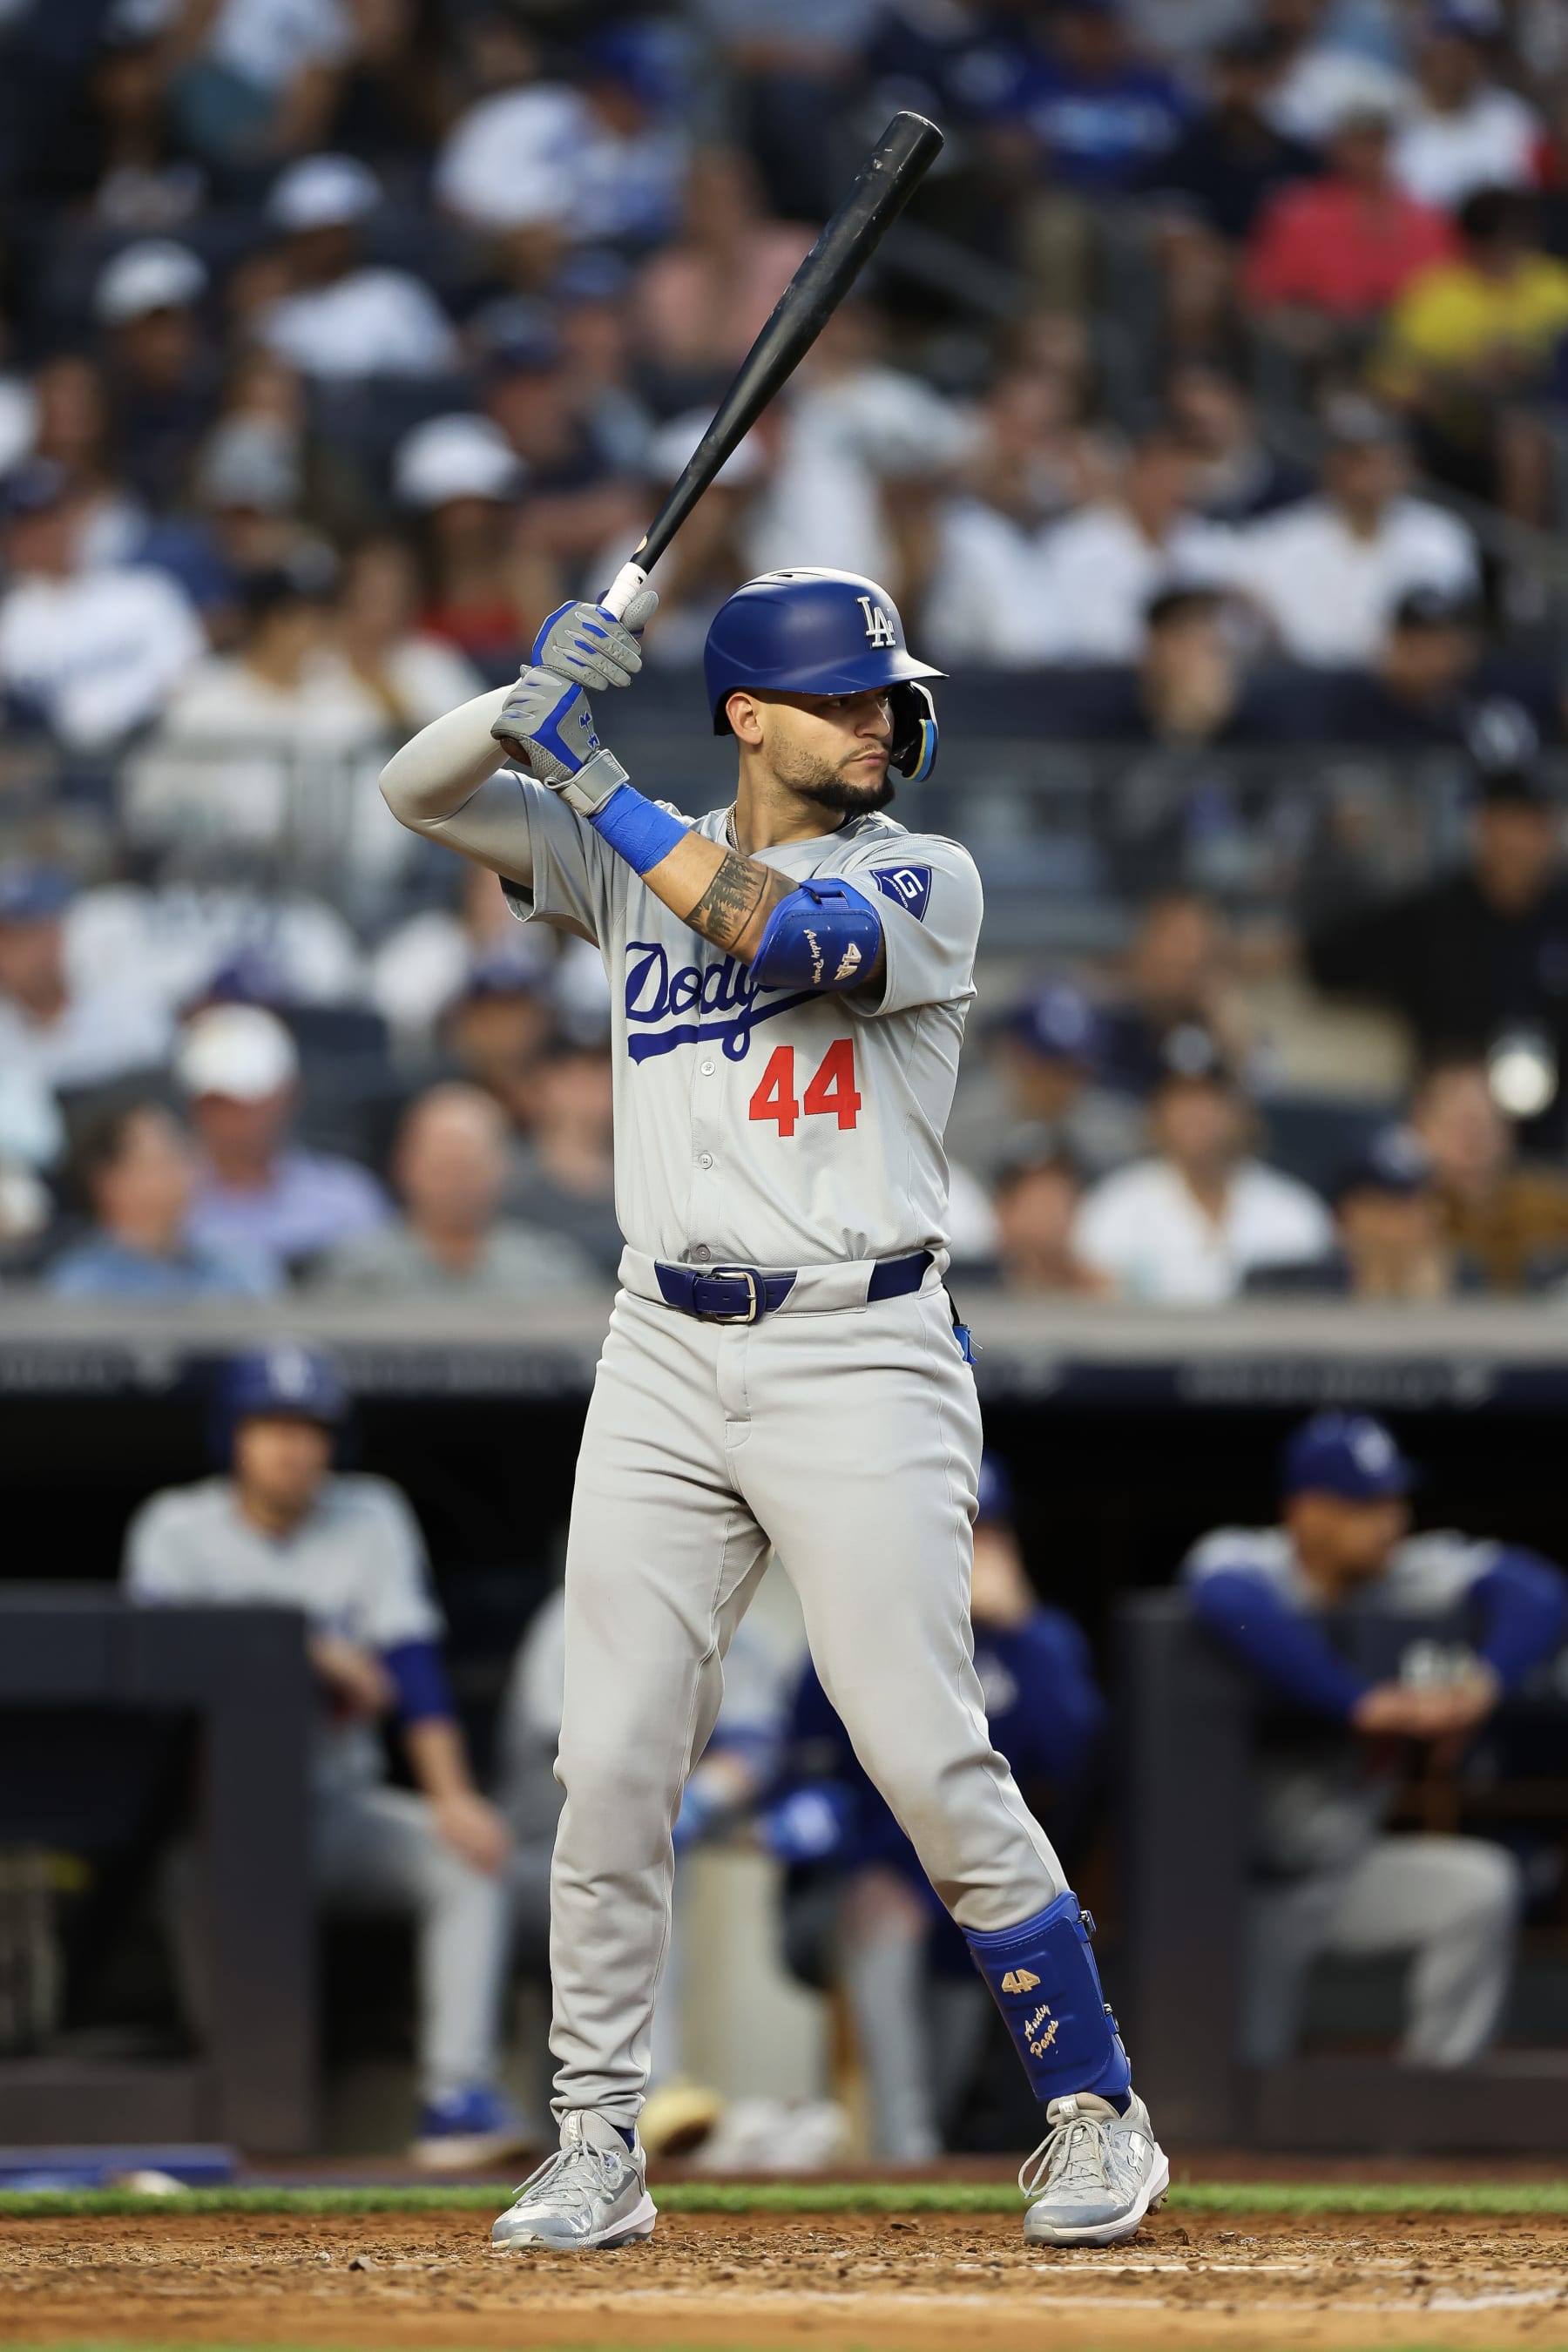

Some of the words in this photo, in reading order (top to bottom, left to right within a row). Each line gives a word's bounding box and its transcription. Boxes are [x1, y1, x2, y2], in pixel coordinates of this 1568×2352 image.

[856, 596, 896, 647] LA
[749, 1038, 861, 1137] 44
[1001, 1969, 1041, 1994] 44
[1024, 2004, 1051, 2042] Andy
[1030, 2020, 1058, 2059] Pages
